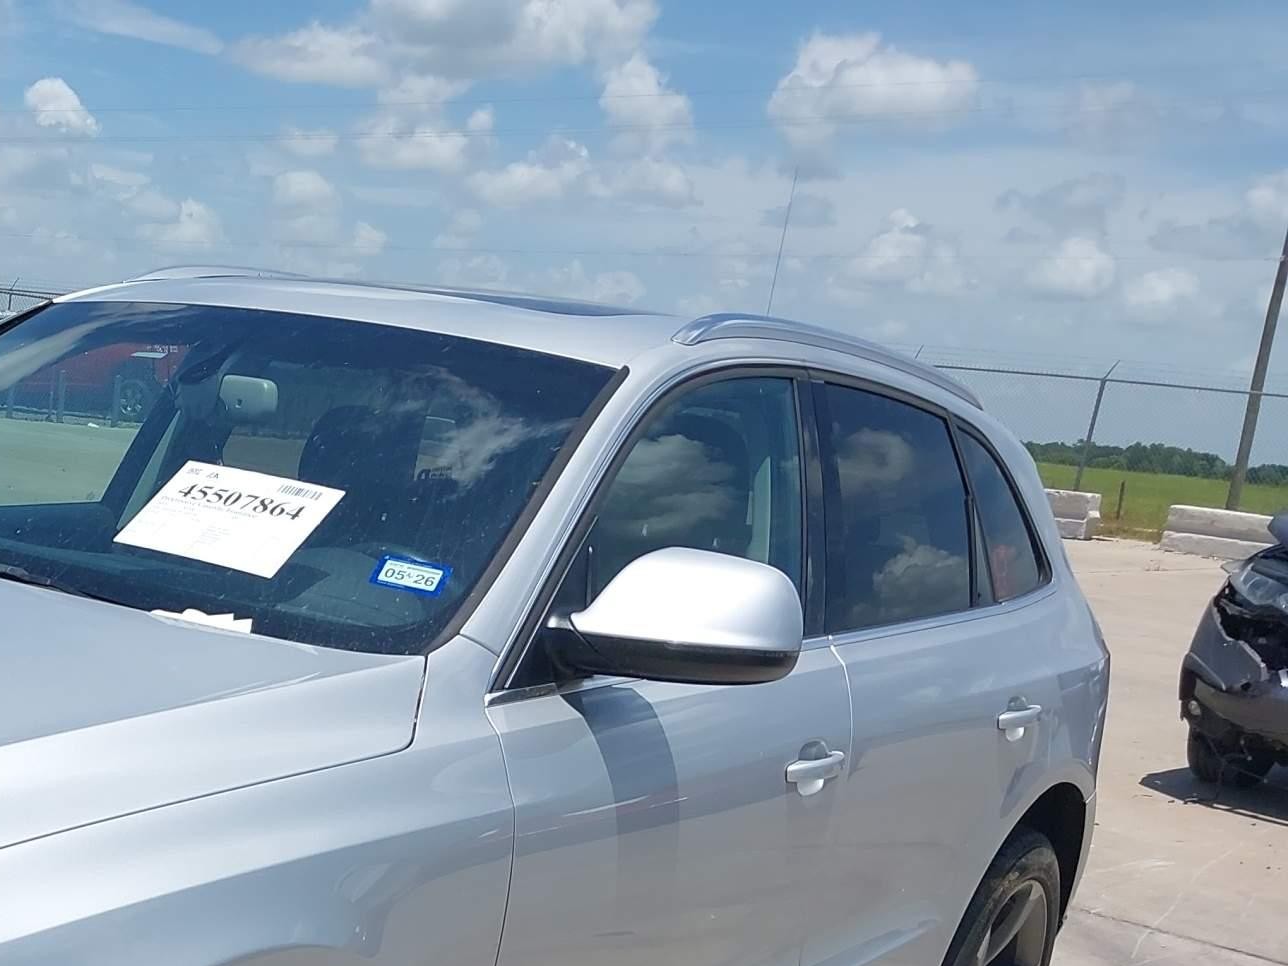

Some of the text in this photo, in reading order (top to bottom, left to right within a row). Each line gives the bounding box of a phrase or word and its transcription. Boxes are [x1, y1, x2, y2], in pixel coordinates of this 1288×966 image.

[178, 482, 306, 521] 45507864
[384, 567, 407, 581] 05
[412, 573, 436, 587] 26
